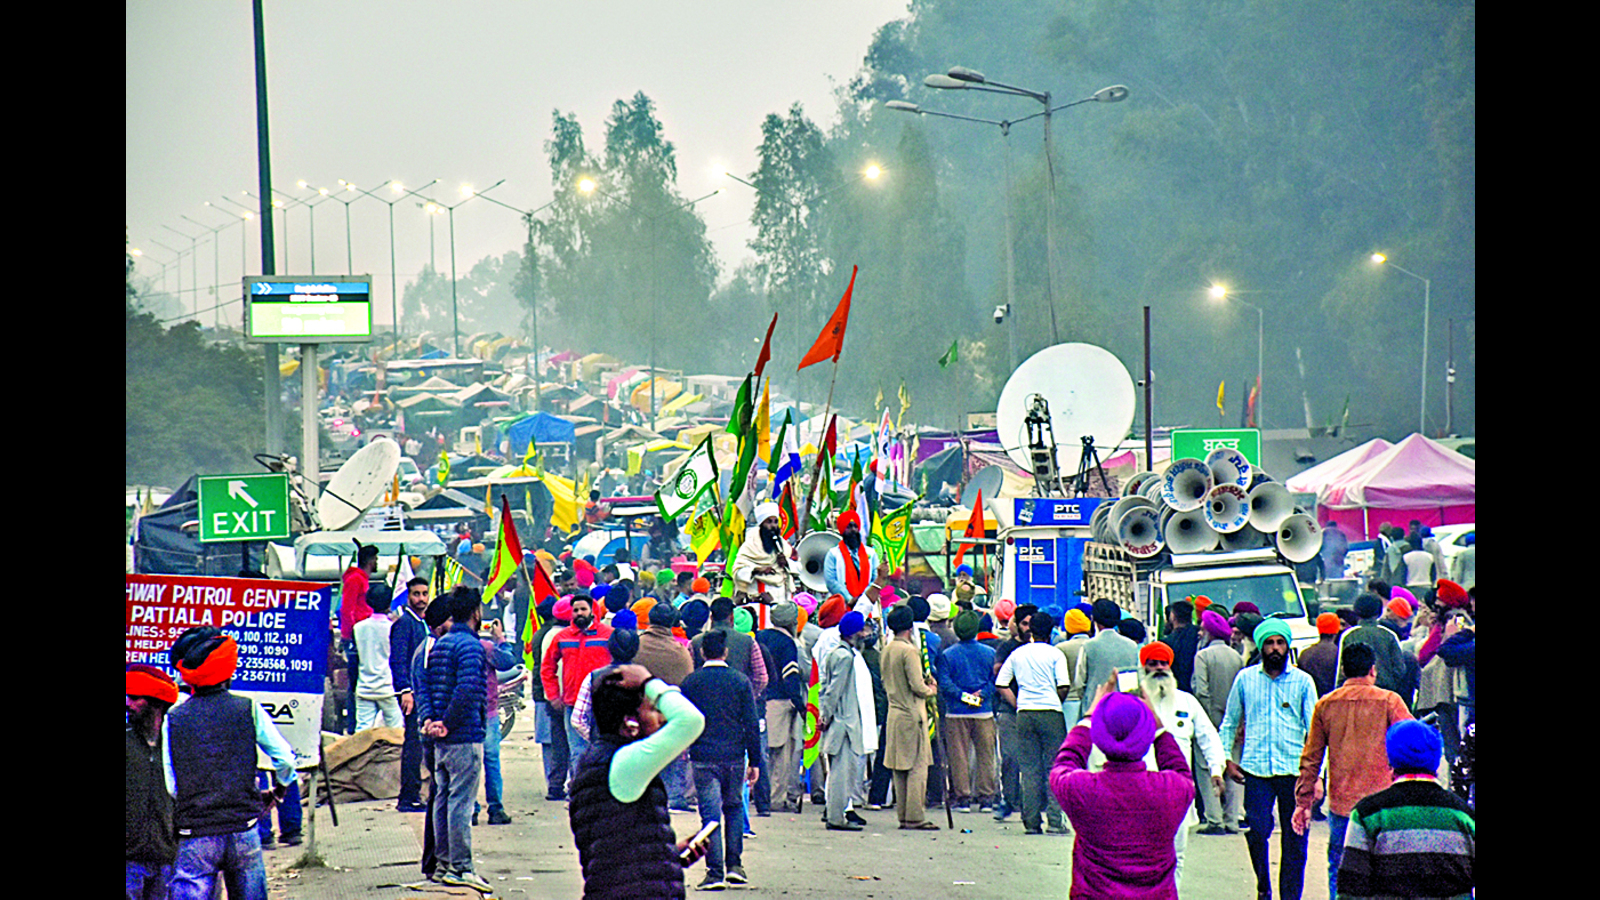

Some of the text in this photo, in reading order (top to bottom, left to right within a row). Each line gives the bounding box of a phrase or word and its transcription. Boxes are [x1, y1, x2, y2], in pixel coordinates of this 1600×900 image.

[1053, 504, 1080, 513] PTC
[213, 510, 276, 534] EXIT
[172, 585, 236, 606] PATROL
[243, 588, 321, 610] CENTER
[131, 605, 286, 629] PATIALA POLICE
[126, 625, 166, 638] INES:-
